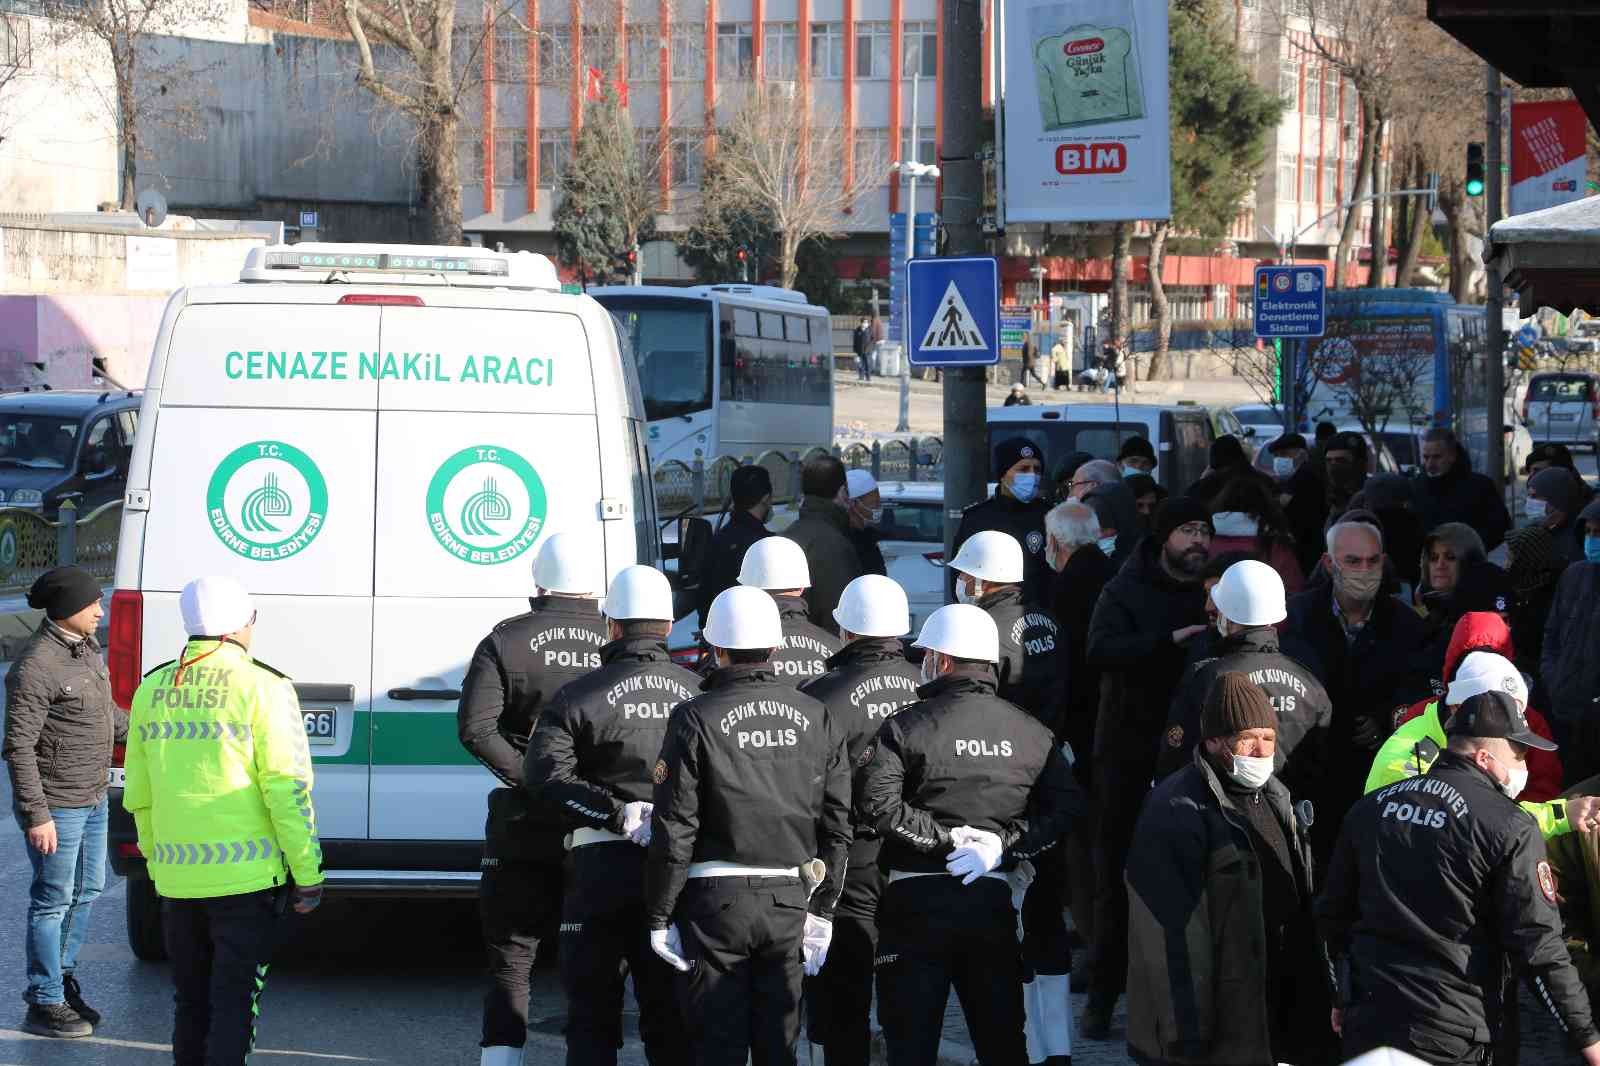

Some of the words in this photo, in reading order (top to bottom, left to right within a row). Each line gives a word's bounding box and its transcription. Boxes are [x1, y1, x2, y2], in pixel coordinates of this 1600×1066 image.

[1262, 301, 1317, 310] Elektronik
[1260, 312, 1319, 321] Denetleme
[1269, 322, 1309, 332] Sistemi
[224, 351, 348, 380] CENAZE
[460, 354, 553, 387] ARACI
[257, 444, 282, 457] T.C.
[476, 449, 501, 461] T.C.
[568, 627, 606, 647] KUVV
[884, 675, 920, 693] KUVV
[1269, 695, 1296, 712] LiS
[758, 700, 810, 732] KUVVET
[1423, 778, 1469, 819] KUVVET
